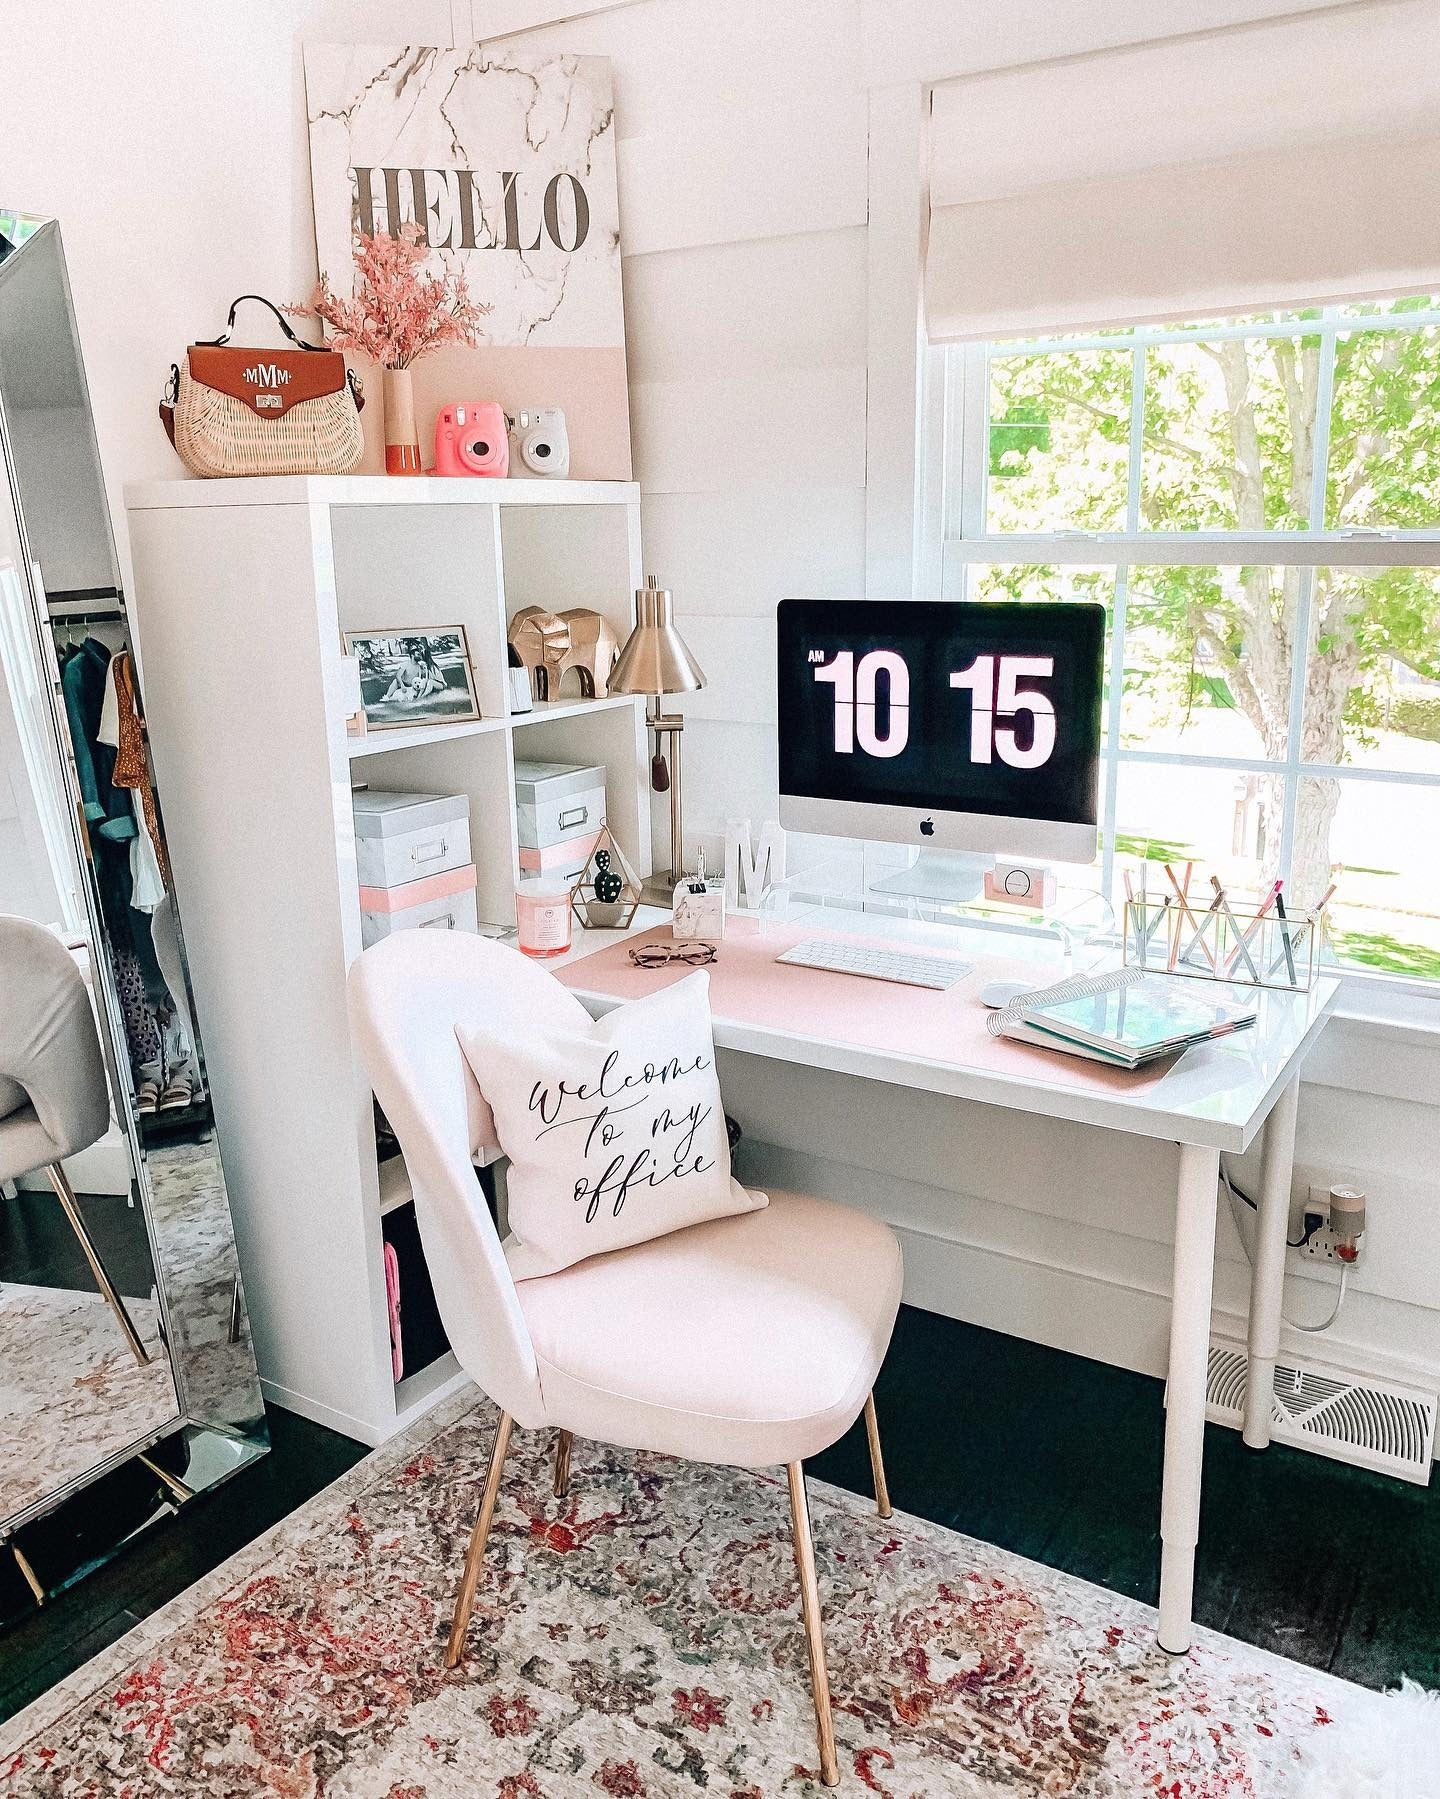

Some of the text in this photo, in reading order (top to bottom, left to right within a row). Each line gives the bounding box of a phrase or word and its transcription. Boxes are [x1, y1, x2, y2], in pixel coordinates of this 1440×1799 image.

[350, 167, 590, 252] HELLO
[807, 649, 1056, 769] AM 10 15
[724, 819, 786, 910] M
[651, 1102, 712, 1163] my
[573, 1149, 715, 1223] office
